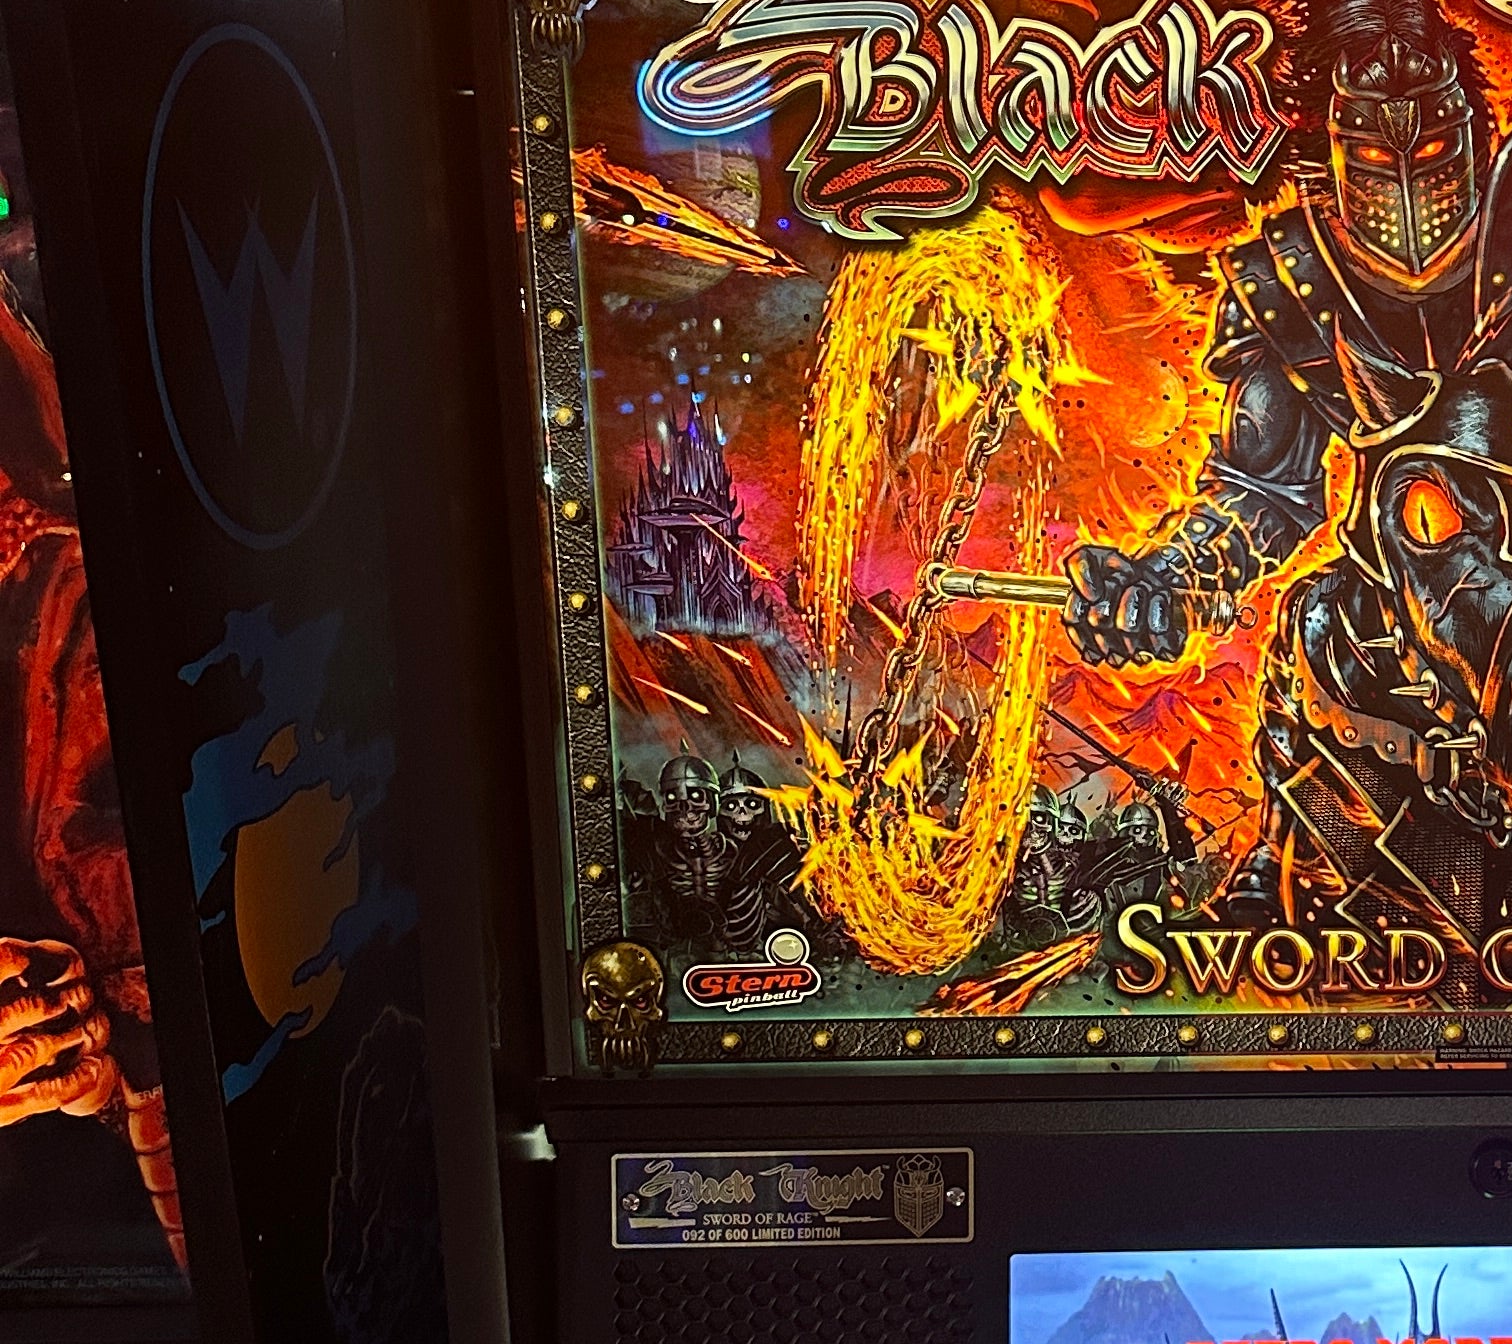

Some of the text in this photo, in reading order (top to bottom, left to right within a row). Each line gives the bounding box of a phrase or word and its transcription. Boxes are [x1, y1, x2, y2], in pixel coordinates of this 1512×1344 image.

[700, 973, 803, 994] Stern
[731, 989, 798, 1007] pinball
[702, 1212, 812, 1226] SWORD OF RAGE
[682, 1227, 841, 1241] 092 OF 600 LIMITED EDITION
